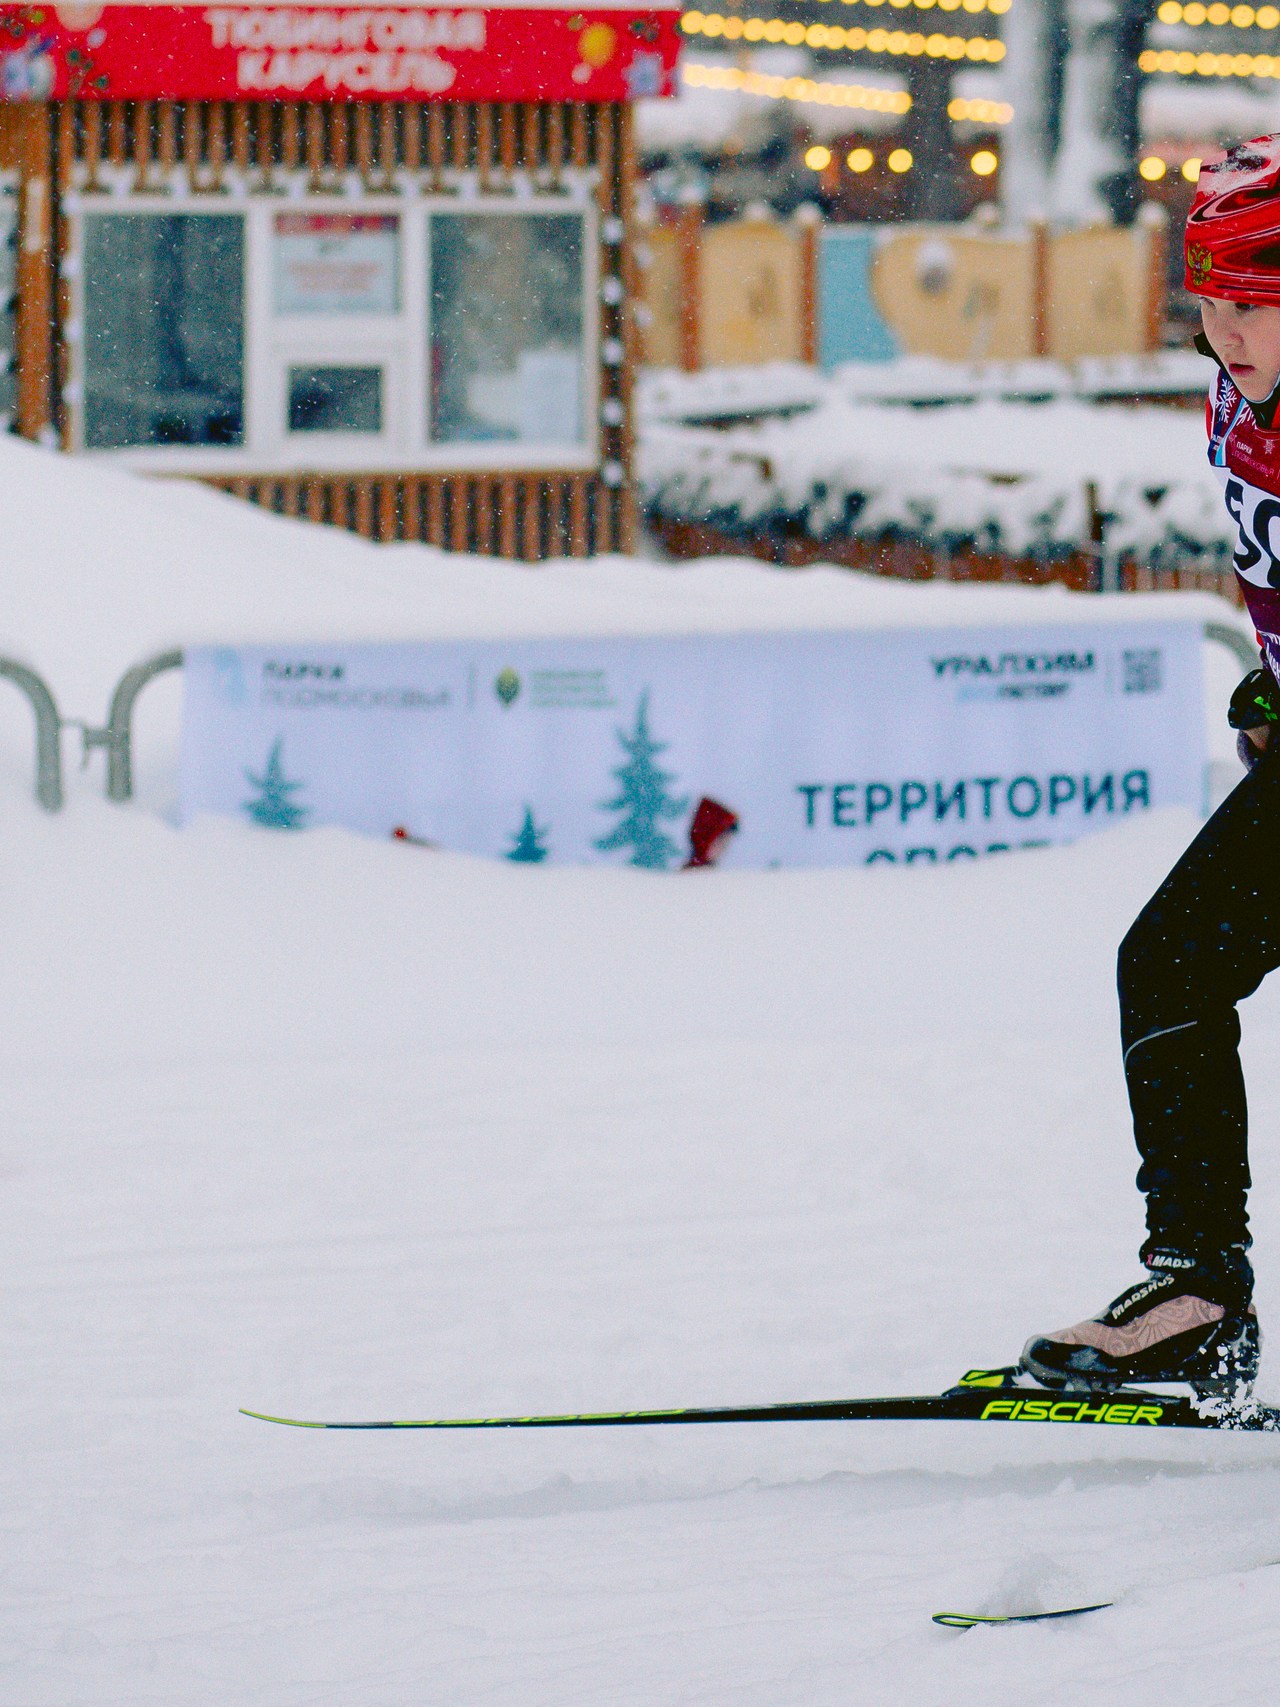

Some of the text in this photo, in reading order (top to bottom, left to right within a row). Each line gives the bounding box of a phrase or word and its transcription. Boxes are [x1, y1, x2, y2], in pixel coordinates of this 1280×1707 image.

[237, 49, 457, 92] КАРУСЕЛЬ
[1236, 441, 1253, 455] ПАРКИ
[796, 769, 1151, 828] ТЕРРИТОРИЯ
[1111, 1273, 1175, 1320] MADSHUS
[980, 1400, 1164, 1426] FISCHER
